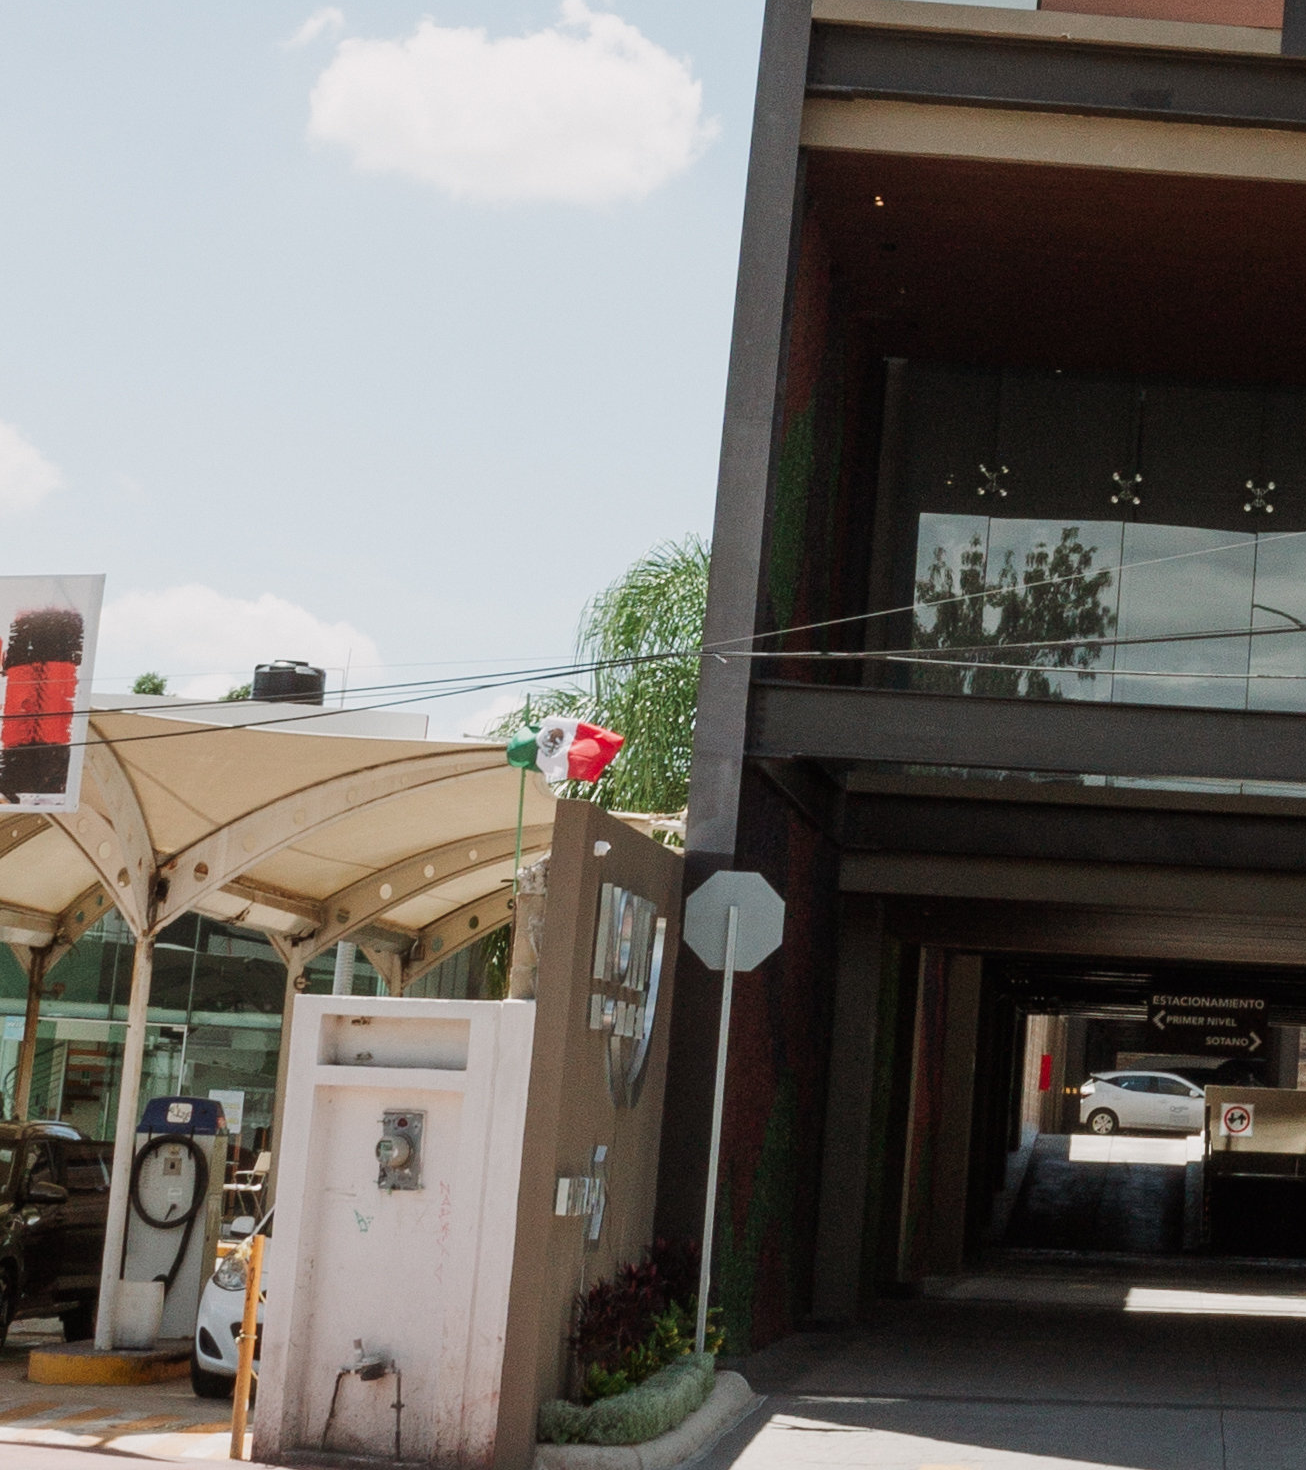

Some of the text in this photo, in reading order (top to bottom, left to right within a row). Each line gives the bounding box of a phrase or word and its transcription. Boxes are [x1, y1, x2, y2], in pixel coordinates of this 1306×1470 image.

[1152, 994, 1265, 1010] ESTACIONAMIENTO
[1166, 1014, 1238, 1028] PRIMER NIVEL
